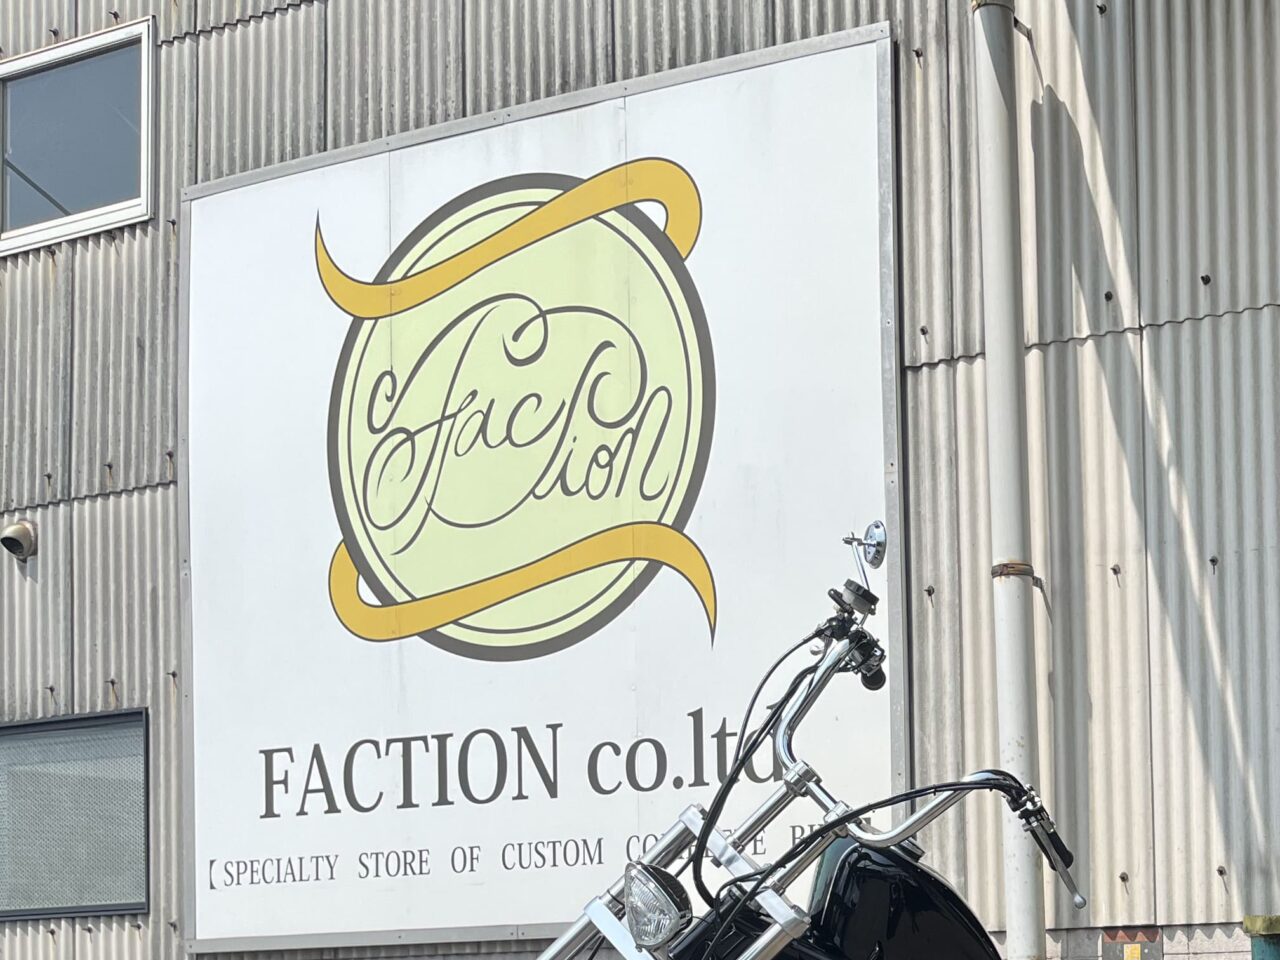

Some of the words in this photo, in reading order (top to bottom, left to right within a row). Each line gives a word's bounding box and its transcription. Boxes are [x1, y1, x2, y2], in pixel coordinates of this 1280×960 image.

[259, 723, 563, 819] FACTION
[358, 848, 431, 879] STORE
[450, 845, 481, 874] OF
[501, 837, 604, 870] CUSTOM
